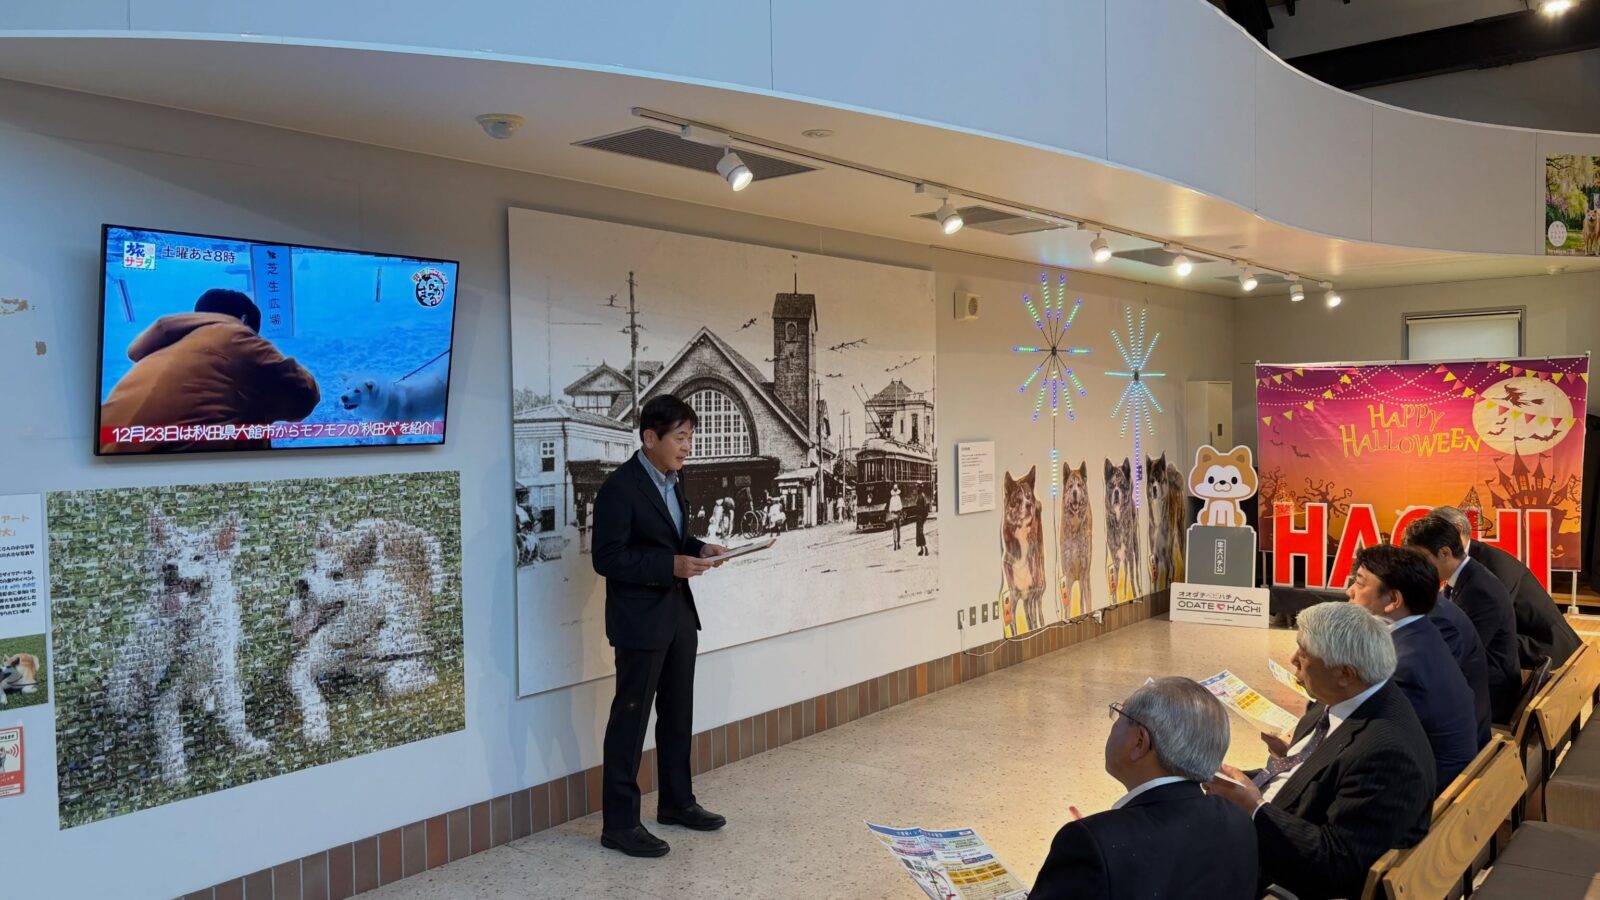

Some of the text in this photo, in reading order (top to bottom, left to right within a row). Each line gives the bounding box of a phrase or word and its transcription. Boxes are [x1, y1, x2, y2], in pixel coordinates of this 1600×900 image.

[126, 242, 146, 258] 旅
[162, 245, 236, 265] 土曜あさ8時
[124, 255, 154, 268] サラダ
[1368, 403, 1445, 432] HAPPY
[1339, 423, 1482, 458] HALLOWEEN
[1177, 600, 1261, 613] ODATE HACHI
